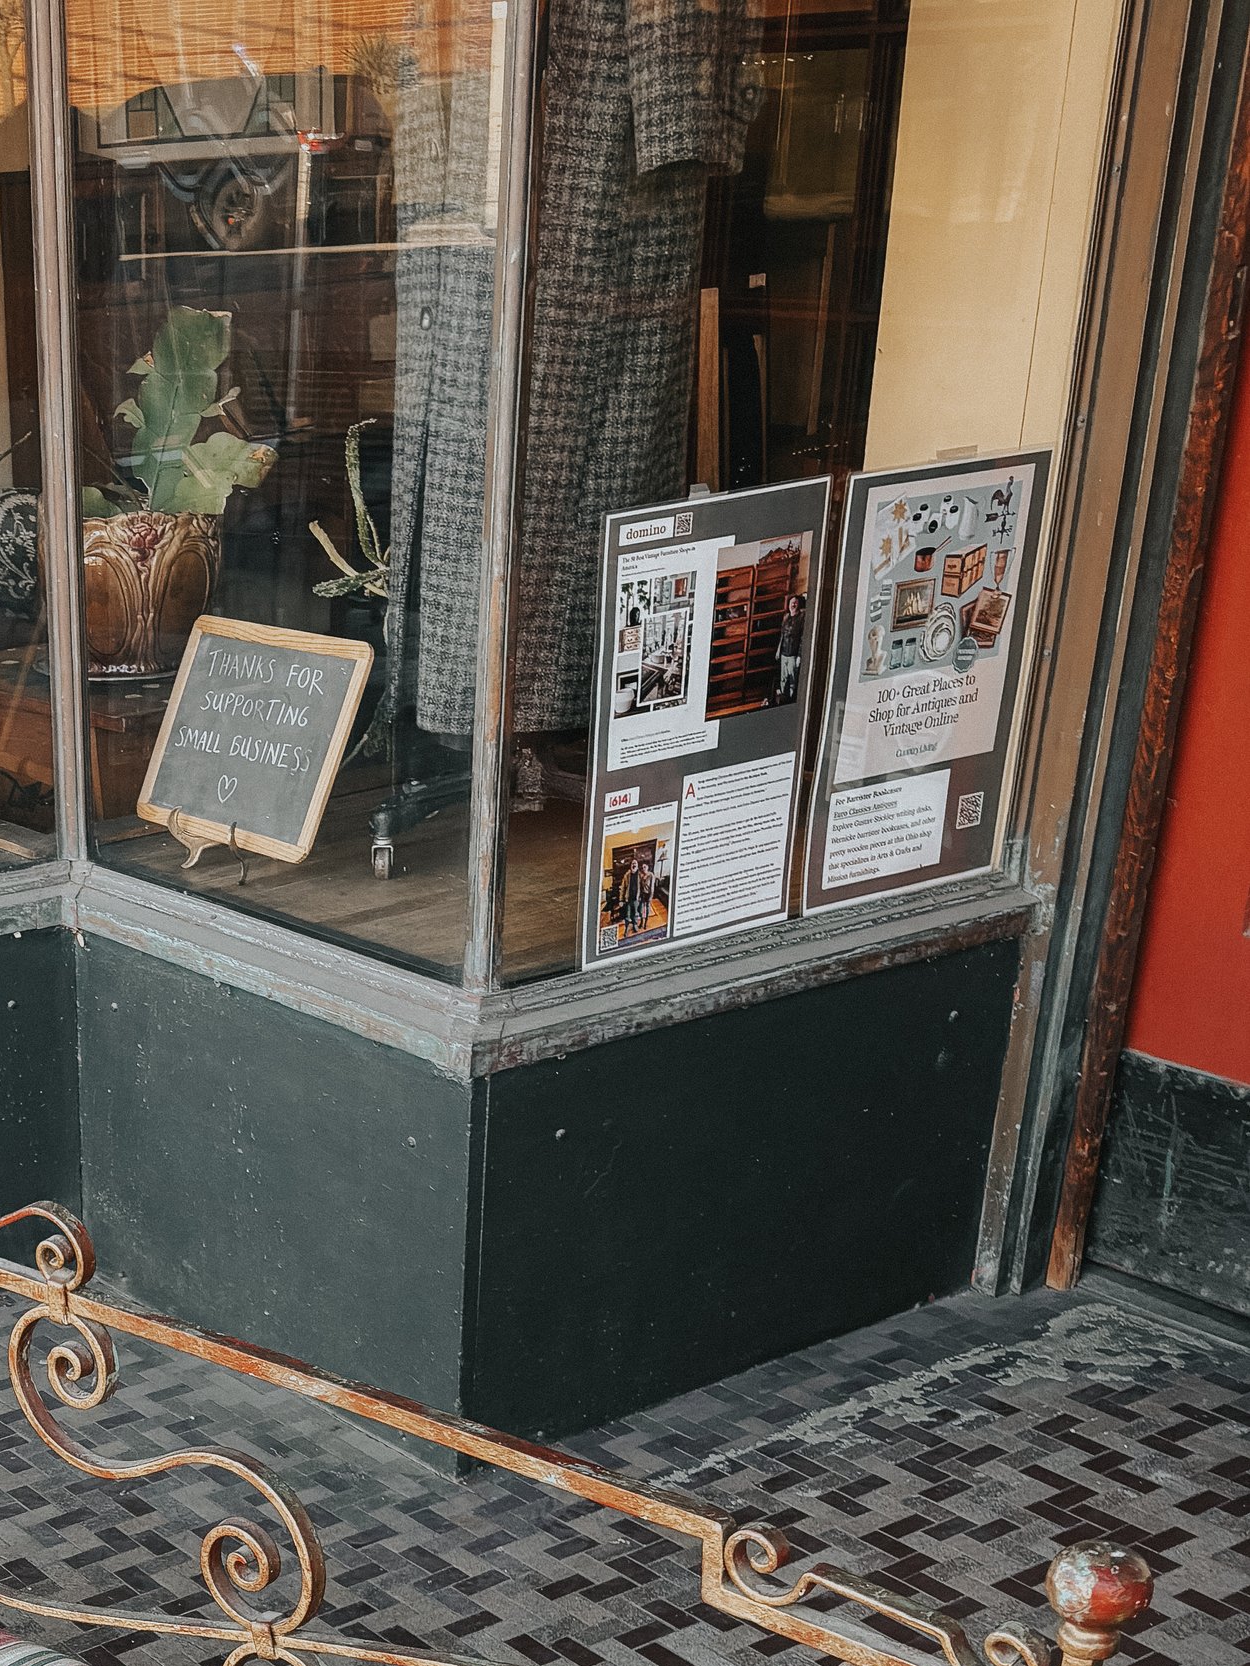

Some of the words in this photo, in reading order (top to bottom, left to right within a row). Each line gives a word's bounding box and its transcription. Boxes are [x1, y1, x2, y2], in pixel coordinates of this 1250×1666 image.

[626, 524, 667, 540] domino
[208, 649, 277, 684] THANKS
[285, 663, 324, 696] FOR
[902, 681, 930, 699] Great
[932, 677, 964, 693] Places
[965, 674, 976, 687] to
[199, 690, 310, 728] SUPPORTING
[868, 708, 895, 723] Shop
[896, 703, 911, 718] for
[911, 697, 958, 715] Antiques
[958, 688, 979, 704] and
[883, 720, 923, 736] Vintage
[924, 712, 959, 729] Online
[174, 725, 222, 754] SMALL
[229, 735, 313, 775] BUSINESS
[895, 747, 919, 758] Country
[685, 783, 696, 800] A
[833, 810, 849, 818] Euro
[910, 818, 921, 827] and
[922, 817, 936, 825] other
[832, 822, 854, 832] Explore
[847, 844, 869, 853] wooden
[905, 832, 919, 841] Ohio
[828, 861, 840, 870] that
[912, 843, 923, 852] and
